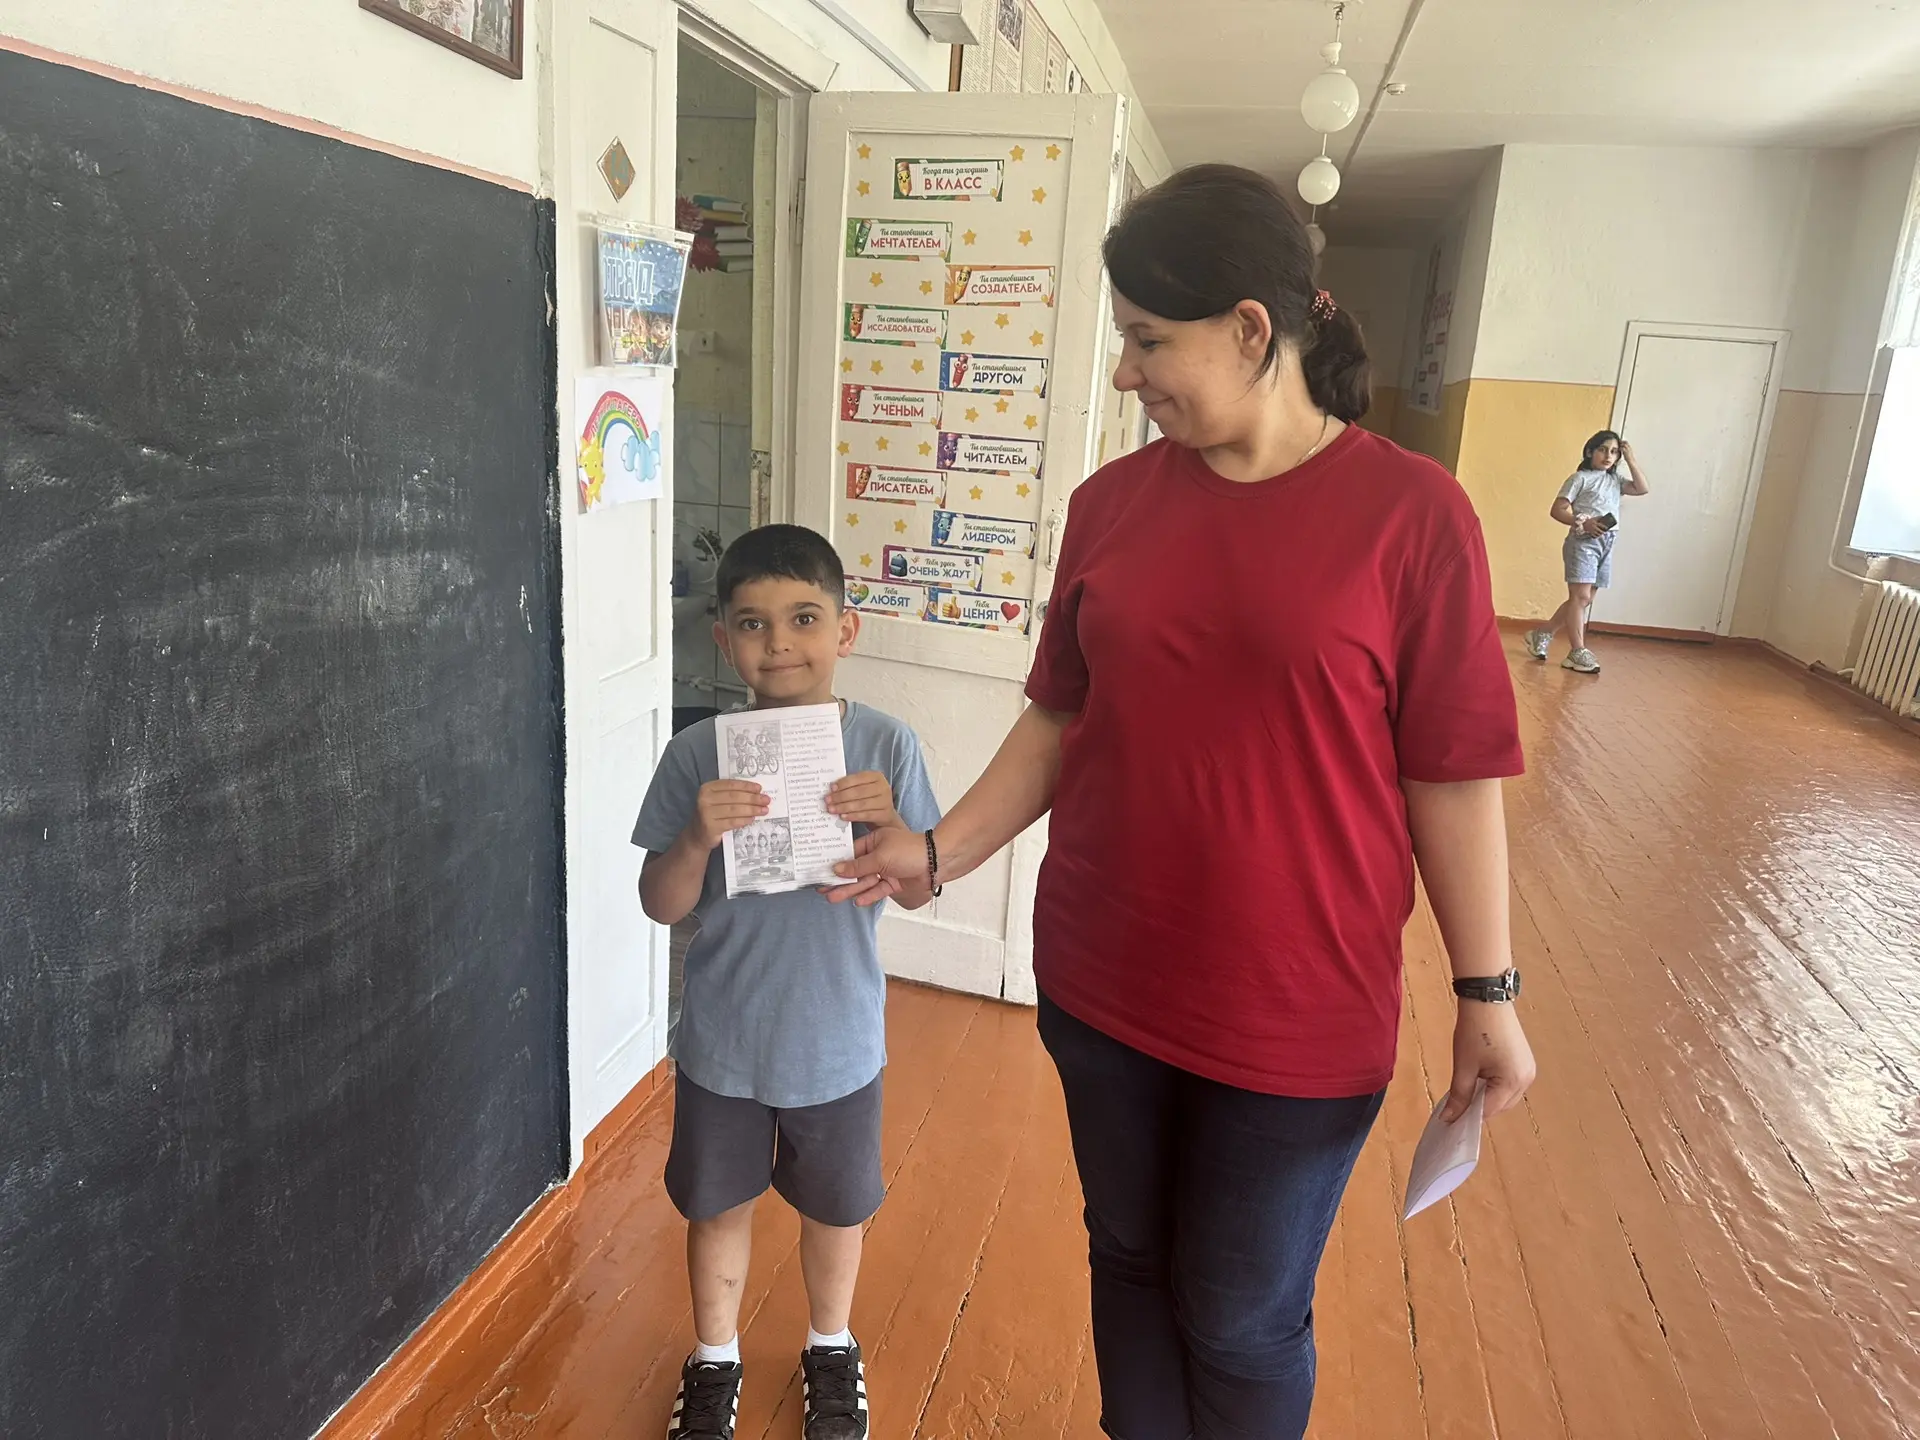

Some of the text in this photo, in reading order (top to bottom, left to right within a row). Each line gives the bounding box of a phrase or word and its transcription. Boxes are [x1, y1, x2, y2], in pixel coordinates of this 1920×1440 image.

[955, 167, 988, 176] заходишь
[924, 176, 982, 190] В КЛАСС
[880, 228, 890, 236] Ты
[870, 238, 941, 248] МЕЧТАТЕЛЕМ
[980, 274, 1035, 283] Ты становишься
[971, 283, 1042, 294] СОЗДАТЕЛЕМ
[876, 315, 929, 324] Ты становишься
[867, 323, 937, 334] ИССЛЕДОВАТЕЛЕМ
[971, 363, 1027, 372] Ты становишься
[972, 372, 1023, 384] ДРУГОМ
[874, 393, 925, 403] Ты становишься
[872, 401, 924, 418] УЧЁНЫМ
[979, 445, 1023, 453] становишься
[964, 452, 1027, 465] ЧИТАТЕЛЕМ
[886, 476, 928, 484] становишься
[870, 482, 934, 495] ПИСАТЕЛЕМ
[973, 525, 1016, 534] становишься
[961, 532, 1016, 545] ЛИДЕРОМ
[925, 558, 939, 566] Тебя
[908, 566, 971, 579] ОЧЕНЬ ЖДУТ
[884, 586, 898, 595] Тебя
[870, 594, 911, 608] ЛЮБЯТ
[975, 600, 990, 608] Тебя
[963, 607, 1000, 621] ЦЕНЯТ
